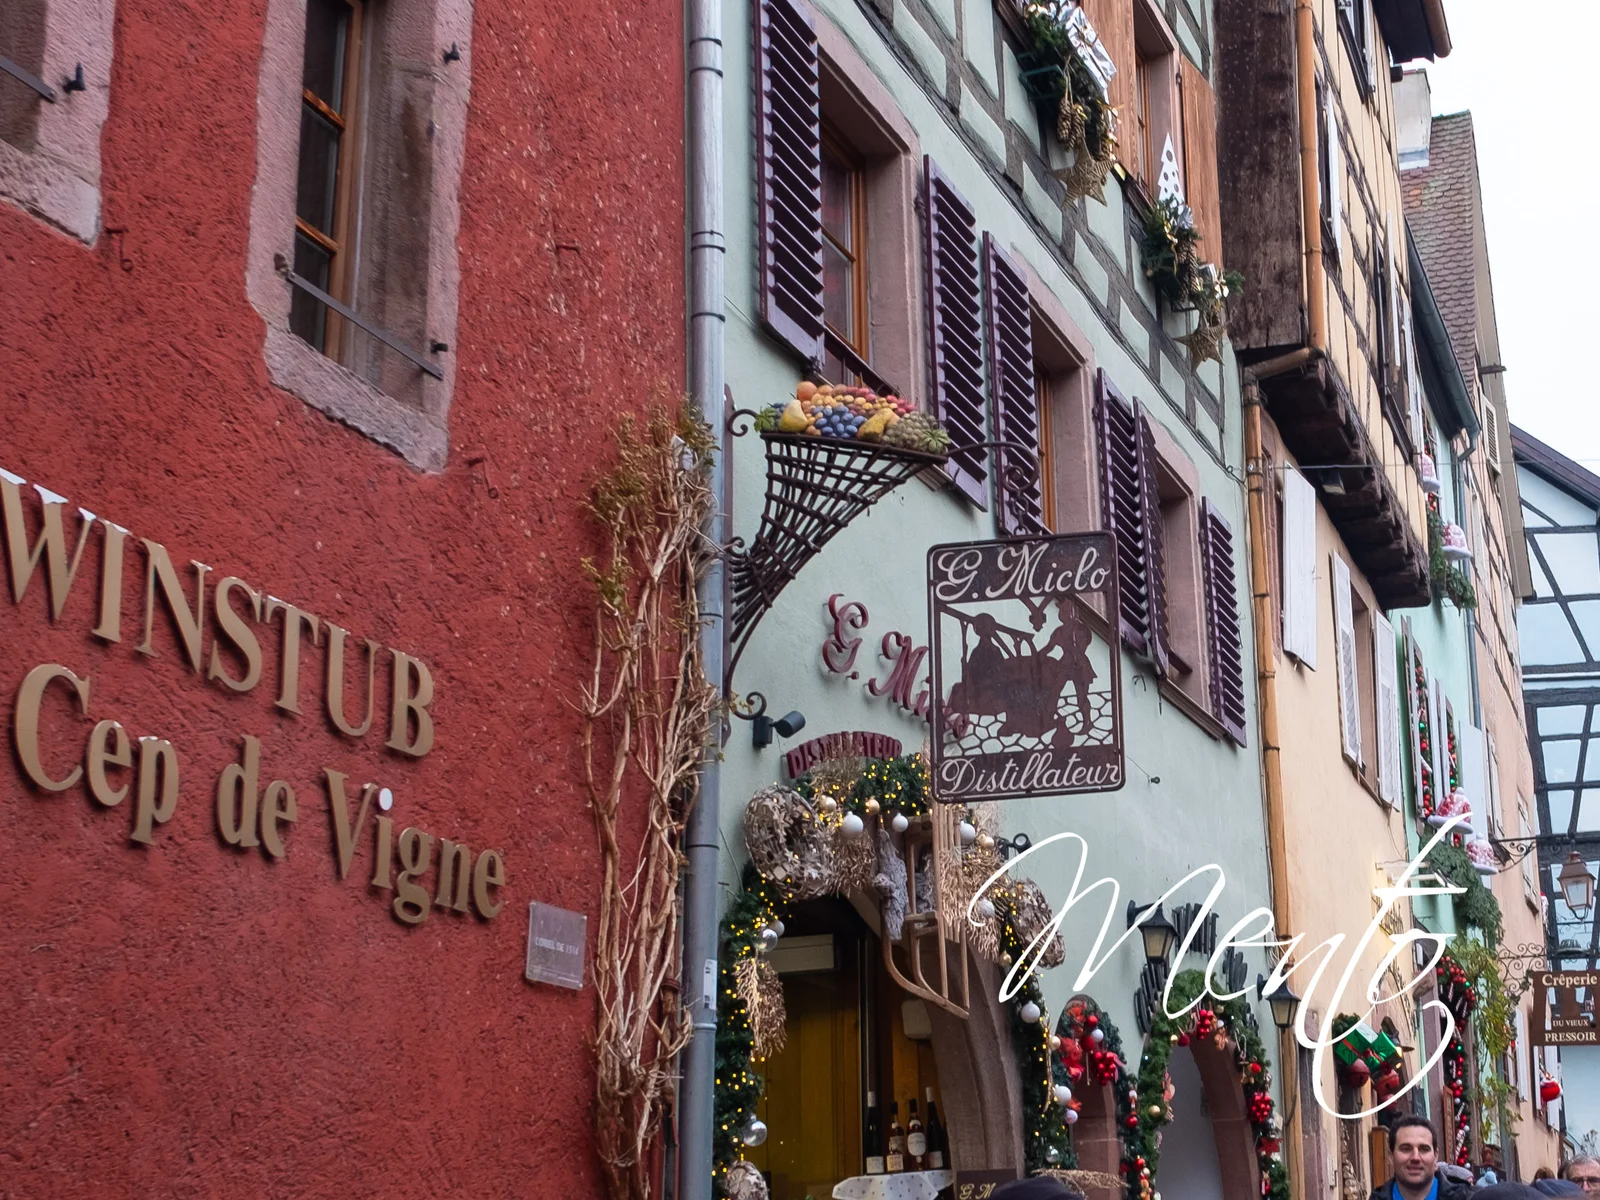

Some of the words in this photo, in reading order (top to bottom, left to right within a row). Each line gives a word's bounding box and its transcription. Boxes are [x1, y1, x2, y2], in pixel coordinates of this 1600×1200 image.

[984, 543, 1112, 599] Miclo
[0, 467, 436, 758] WINSTUB
[15, 663, 180, 845] Cep
[216, 734, 298, 858] de
[323, 768, 506, 924] Vigne
[938, 751, 1121, 796] Distillateur
[1541, 973, 1598, 989] Crêperie
[1544, 1031, 1597, 1042] PRESSOIR
[1552, 1019, 1564, 1027] DU
[1565, 1019, 1589, 1027] VIEUX
